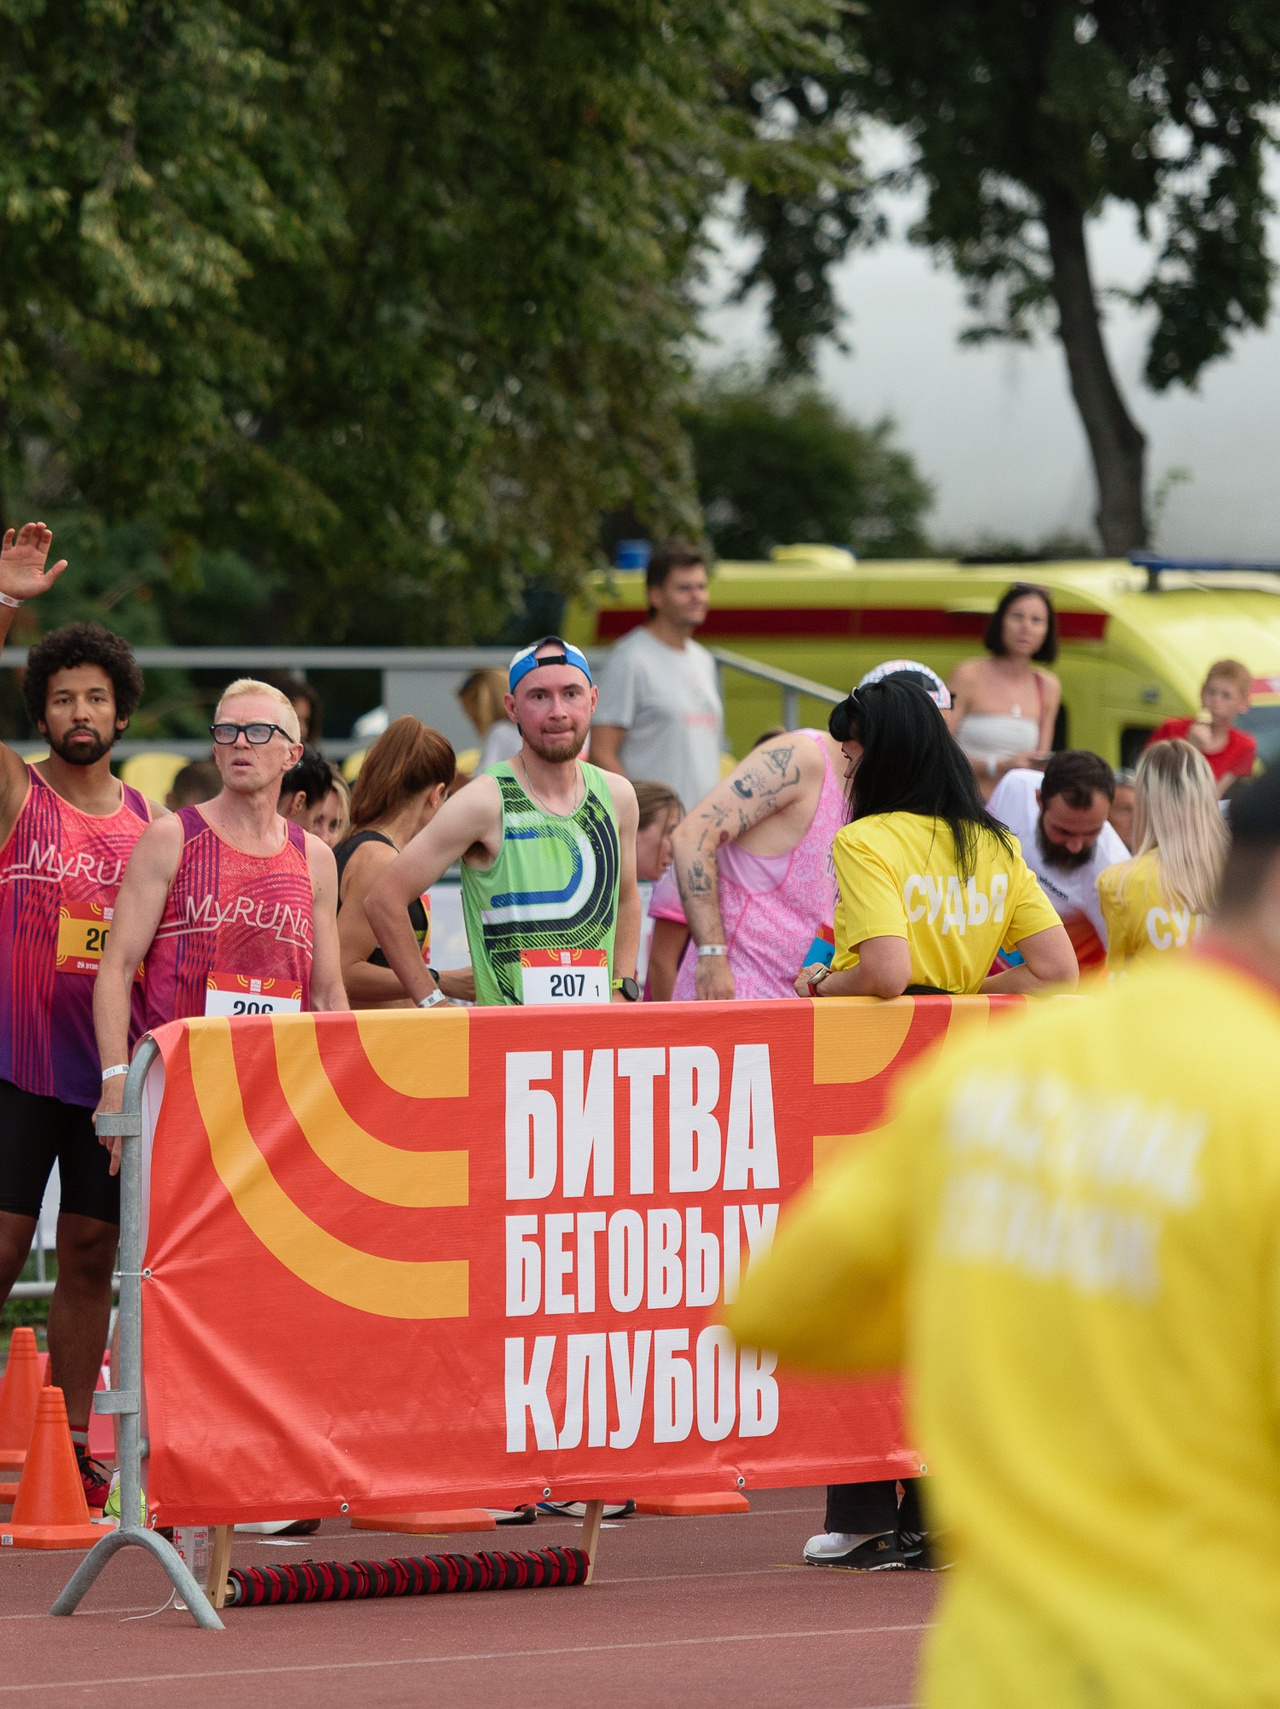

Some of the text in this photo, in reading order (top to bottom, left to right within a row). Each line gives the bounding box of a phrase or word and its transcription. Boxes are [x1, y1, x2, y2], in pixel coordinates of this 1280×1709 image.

[26, 840, 122, 882] MyRU
[903, 873, 1009, 936] СУДЬЯ
[86, 928, 109, 952] 20
[550, 974, 600, 997] 207 1
[505, 1044, 780, 1200] БИТВА
[505, 1204, 780, 1317] БЕГОВЫХ
[505, 1325, 780, 1453] КЛУБОВ
